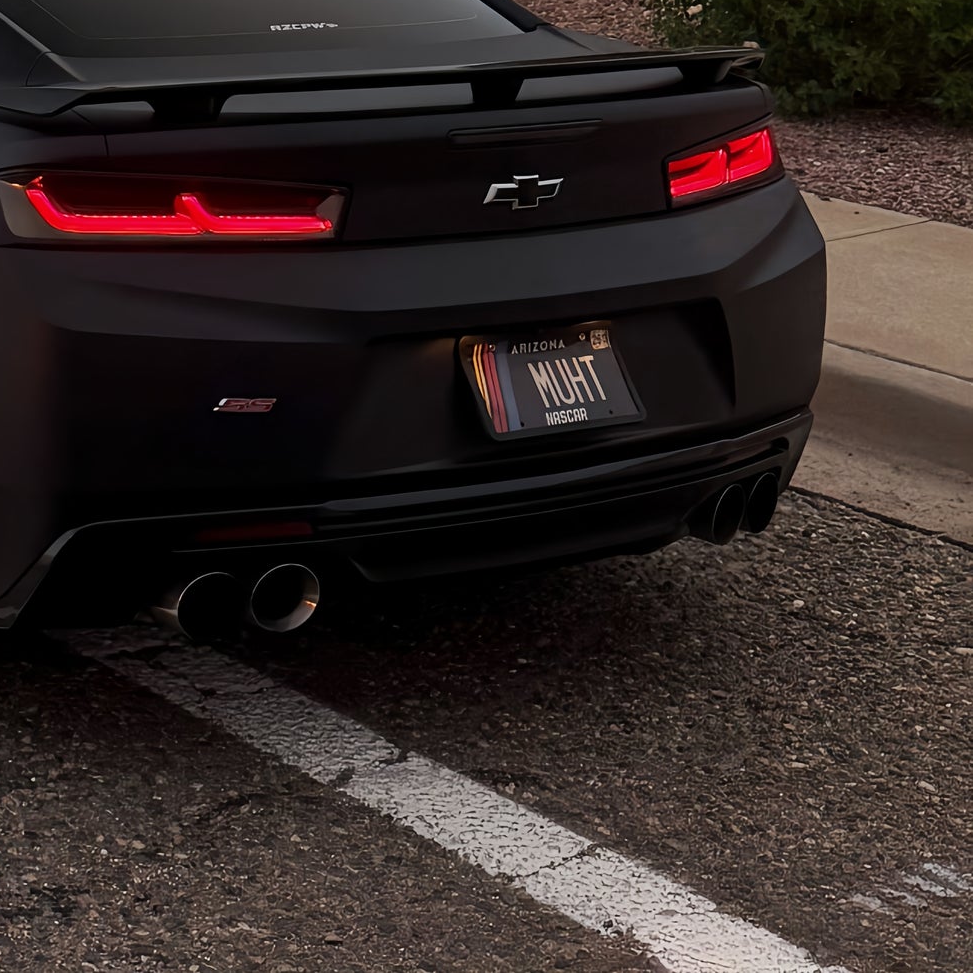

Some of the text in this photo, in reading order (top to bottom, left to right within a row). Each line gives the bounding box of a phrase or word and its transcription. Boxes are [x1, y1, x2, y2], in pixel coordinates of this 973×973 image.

[511, 339, 566, 355] ARIZONA
[527, 355, 607, 408] MUHT
[545, 407, 589, 427] NASCAR
